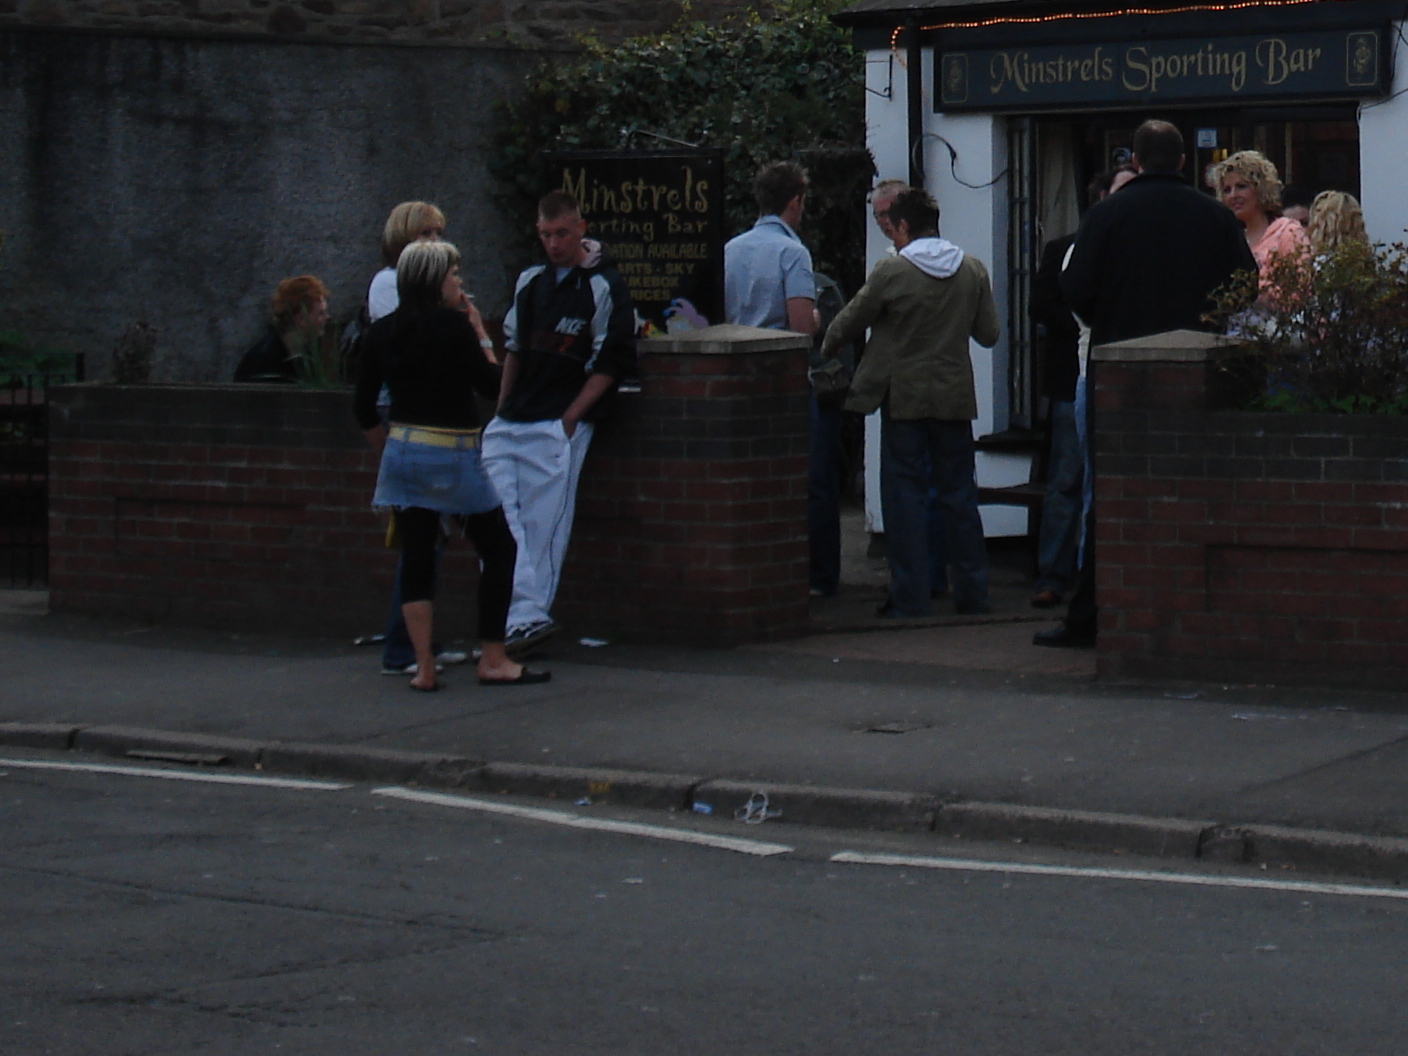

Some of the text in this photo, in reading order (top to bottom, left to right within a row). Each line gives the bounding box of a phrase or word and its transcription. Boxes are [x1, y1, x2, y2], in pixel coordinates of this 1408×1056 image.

[990, 39, 1322, 94] Minstrels Sporting Bar
[562, 165, 708, 214] Minstrels
[587, 213, 708, 243] orting Bar
[647, 243, 708, 259] AVAILABLE
[616, 262, 695, 275] ARTS SKY
[622, 276, 679, 288] UKEBOX
[630, 289, 671, 301] RICES
